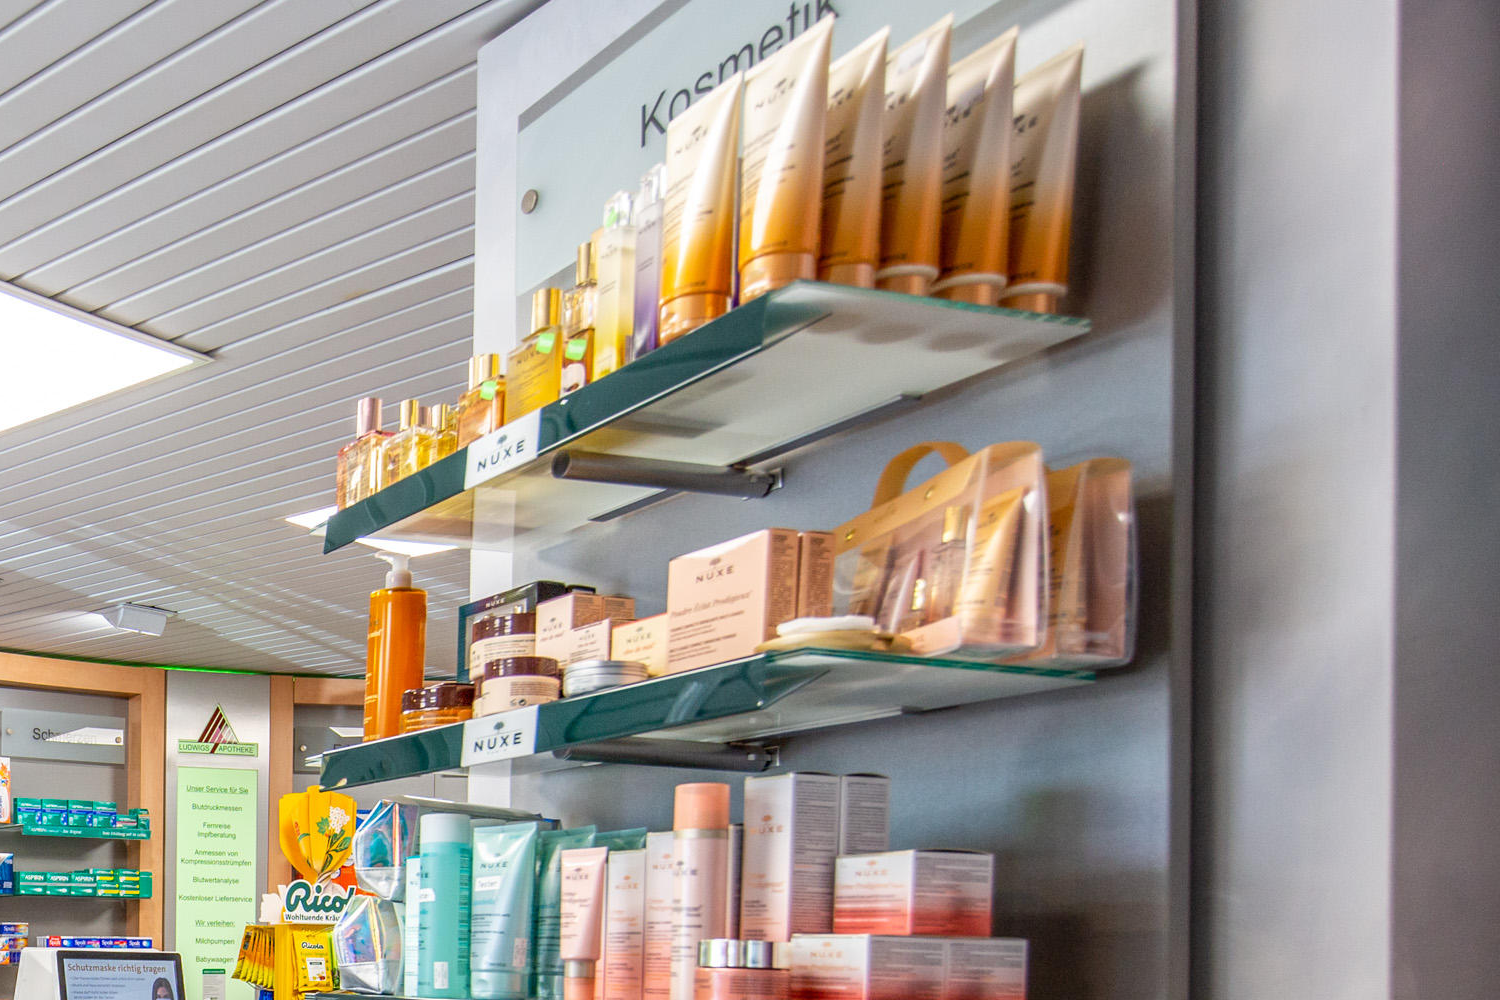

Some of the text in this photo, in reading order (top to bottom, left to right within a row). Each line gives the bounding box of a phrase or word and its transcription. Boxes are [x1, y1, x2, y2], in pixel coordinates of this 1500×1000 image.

[476, 439, 525, 472] NUXE
[695, 565, 733, 583] NUXE
[473, 732, 522, 753] NUXE
[178, 743, 254, 754] LUDWIGS APOTHEKE
[206, 785, 229, 793] Service
[191, 803, 242, 812] Blutdruckmessen
[202, 821, 231, 829] Fernreise
[197, 831, 236, 840] Impfberatung
[194, 849, 225, 857] Anmessen
[192, 876, 240, 885] Blutwertanalyse
[215, 895, 253, 903] Lieferservice
[195, 938, 235, 946] Milchpumpen
[195, 956, 235, 965] Babywaagen
[67, 963, 166, 975] Schutzmaske richtig tragen
